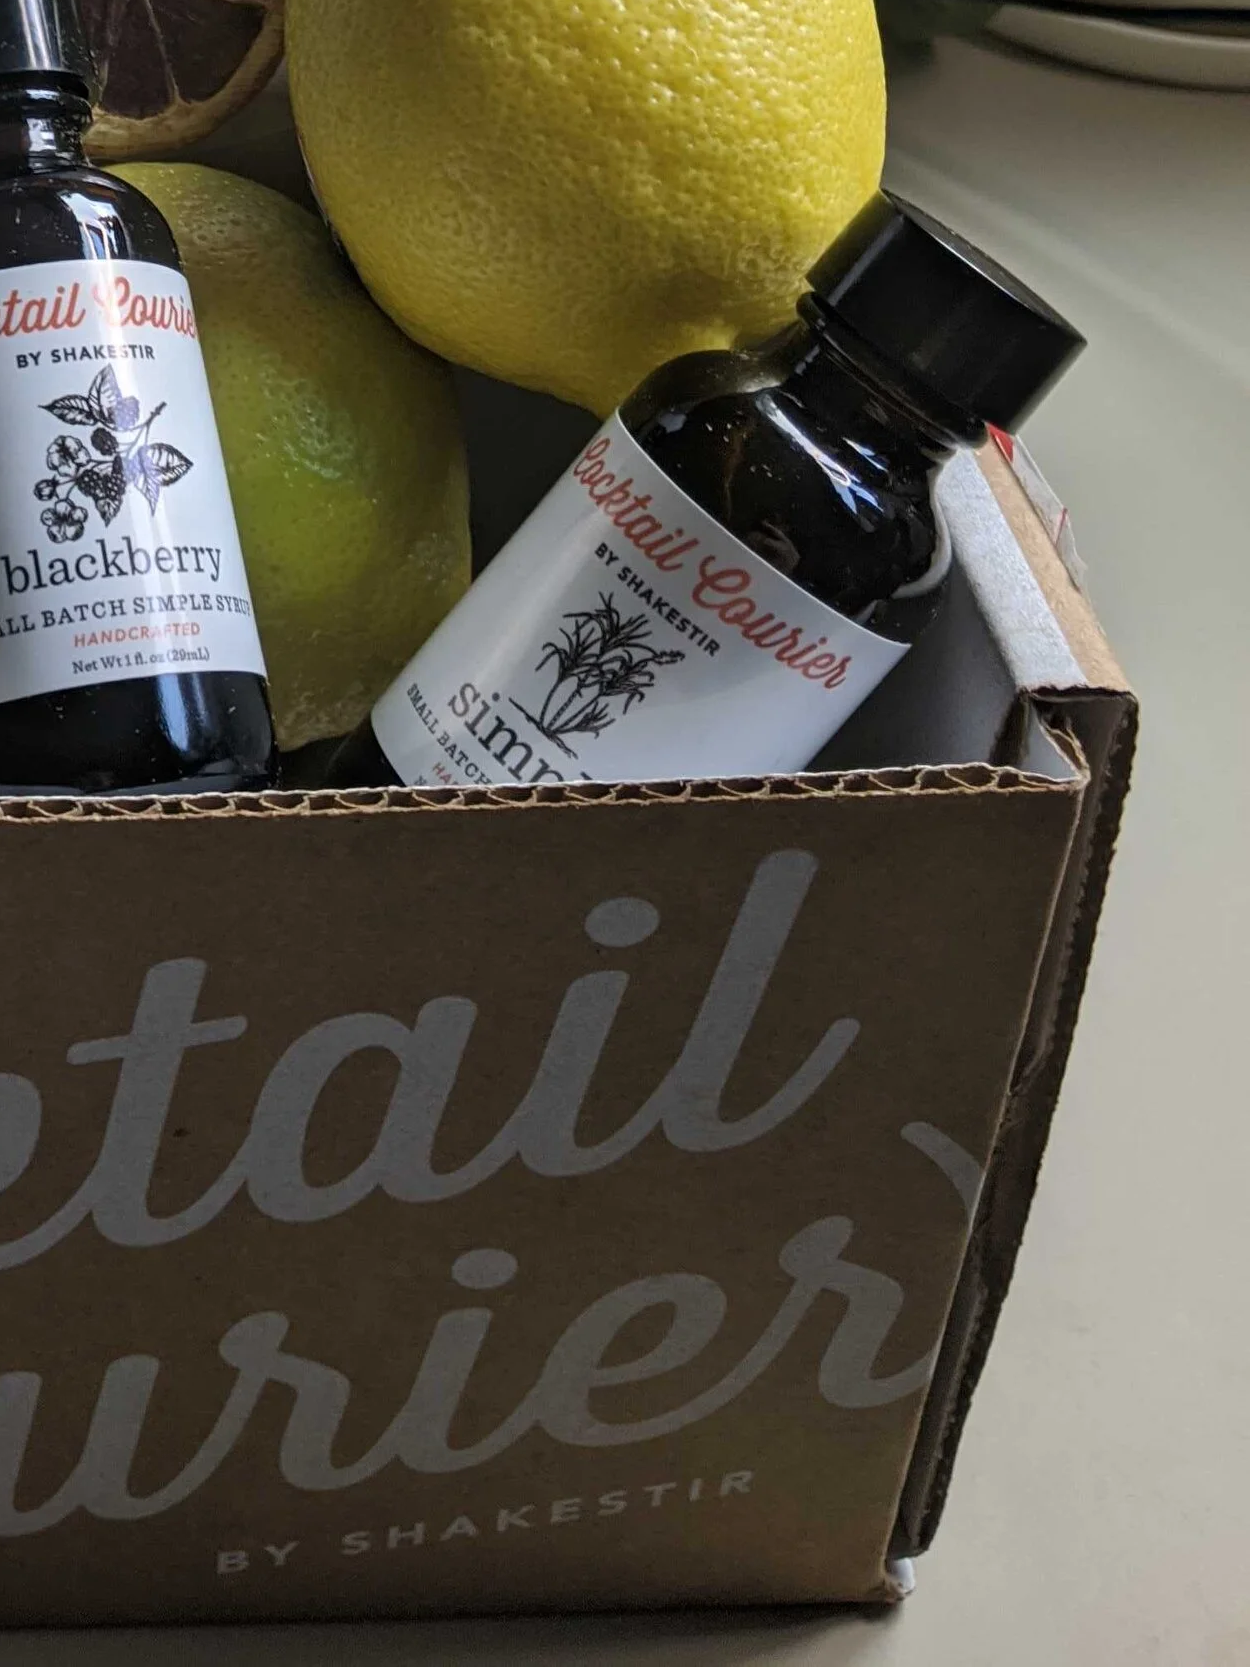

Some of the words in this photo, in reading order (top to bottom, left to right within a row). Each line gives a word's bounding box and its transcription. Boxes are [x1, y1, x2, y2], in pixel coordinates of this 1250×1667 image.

[92, 275, 197, 340] Courie
[16, 351, 42, 369] BY
[51, 344, 156, 364] SHAKESTIR
[0, 534, 222, 596] blackberry
[572, 437, 701, 574] Cocktail
[691, 555, 853, 691] Courier
[40, 598, 126, 629] BATCH
[132, 593, 213, 615] SIMPLE
[594, 542, 618, 568] BY
[616, 567, 722, 658] SHAKESTIR
[72, 658, 98, 675] Net
[100, 655, 124, 670] Wt
[133, 650, 148, 666] fl.
[149, 653, 165, 664] oz
[165, 647, 211, 665] (29mL)
[73, 621, 201, 648] HANDCRAFTED
[406, 683, 438, 735] SMALL
[437, 731, 492, 784] BATCH
[216, 1540, 299, 1576] BY
[340, 1470, 756, 1558] SHAKESTIR
